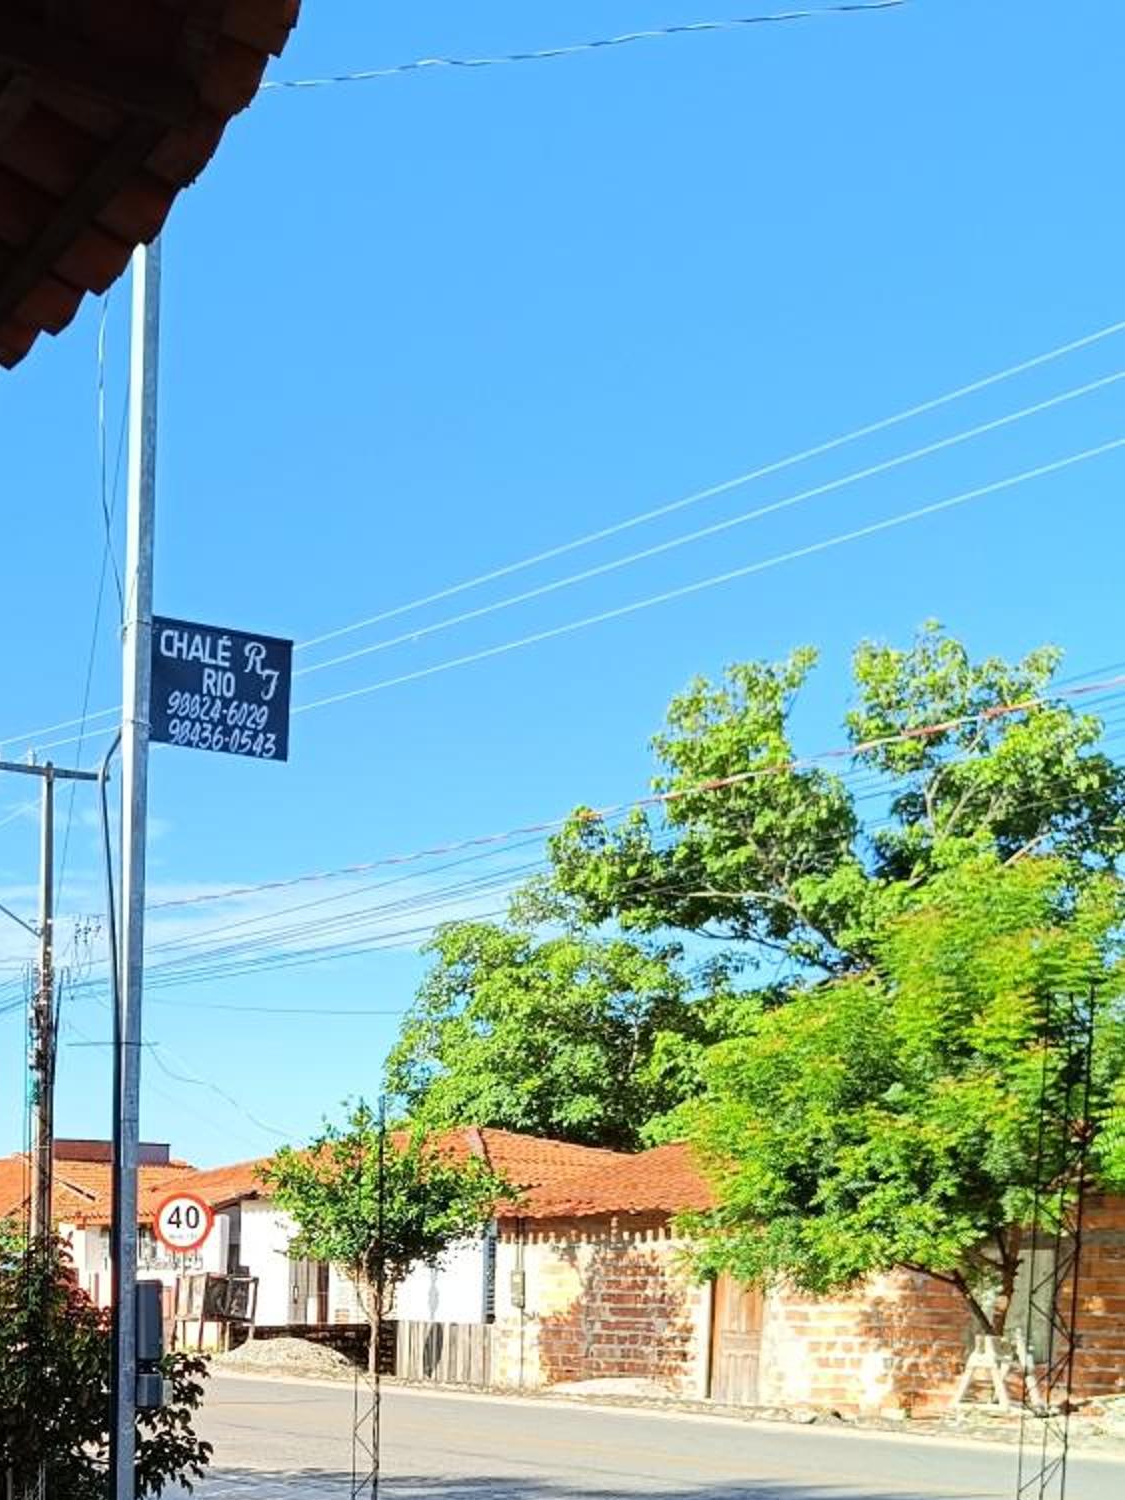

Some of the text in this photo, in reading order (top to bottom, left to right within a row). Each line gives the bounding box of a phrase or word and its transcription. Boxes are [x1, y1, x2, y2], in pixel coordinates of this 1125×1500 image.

[161, 630, 232, 667] CHALÉ
[203, 668, 236, 698] RIO
[169, 719, 276, 758] 98436-0543
[167, 1205, 200, 1229] 40
